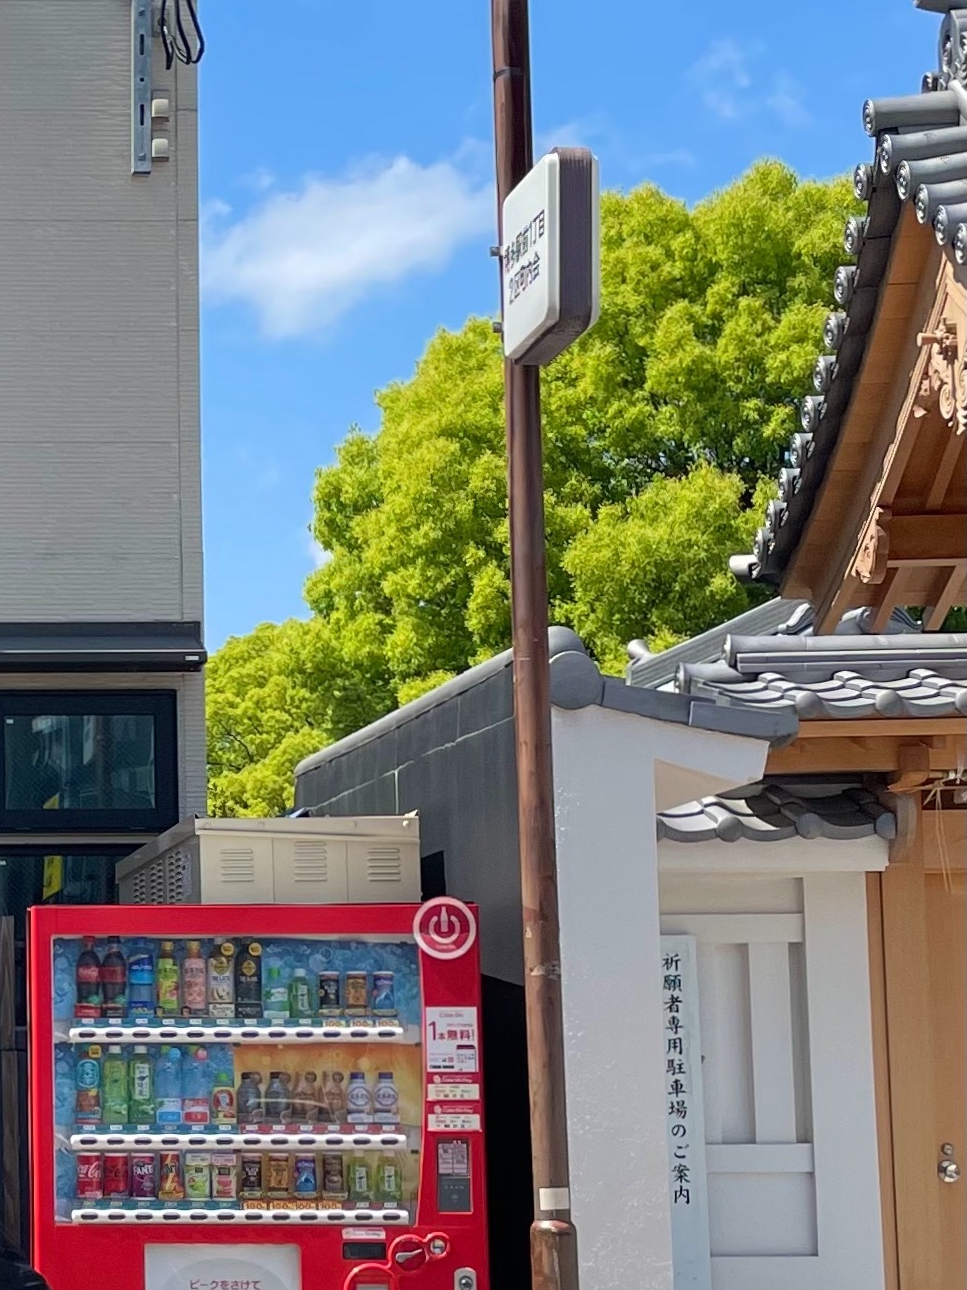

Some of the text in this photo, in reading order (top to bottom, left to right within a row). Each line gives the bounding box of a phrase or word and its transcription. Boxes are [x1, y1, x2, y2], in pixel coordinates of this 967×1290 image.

[662, 953, 691, 1205] 祈願者専用駐車場のご案内
